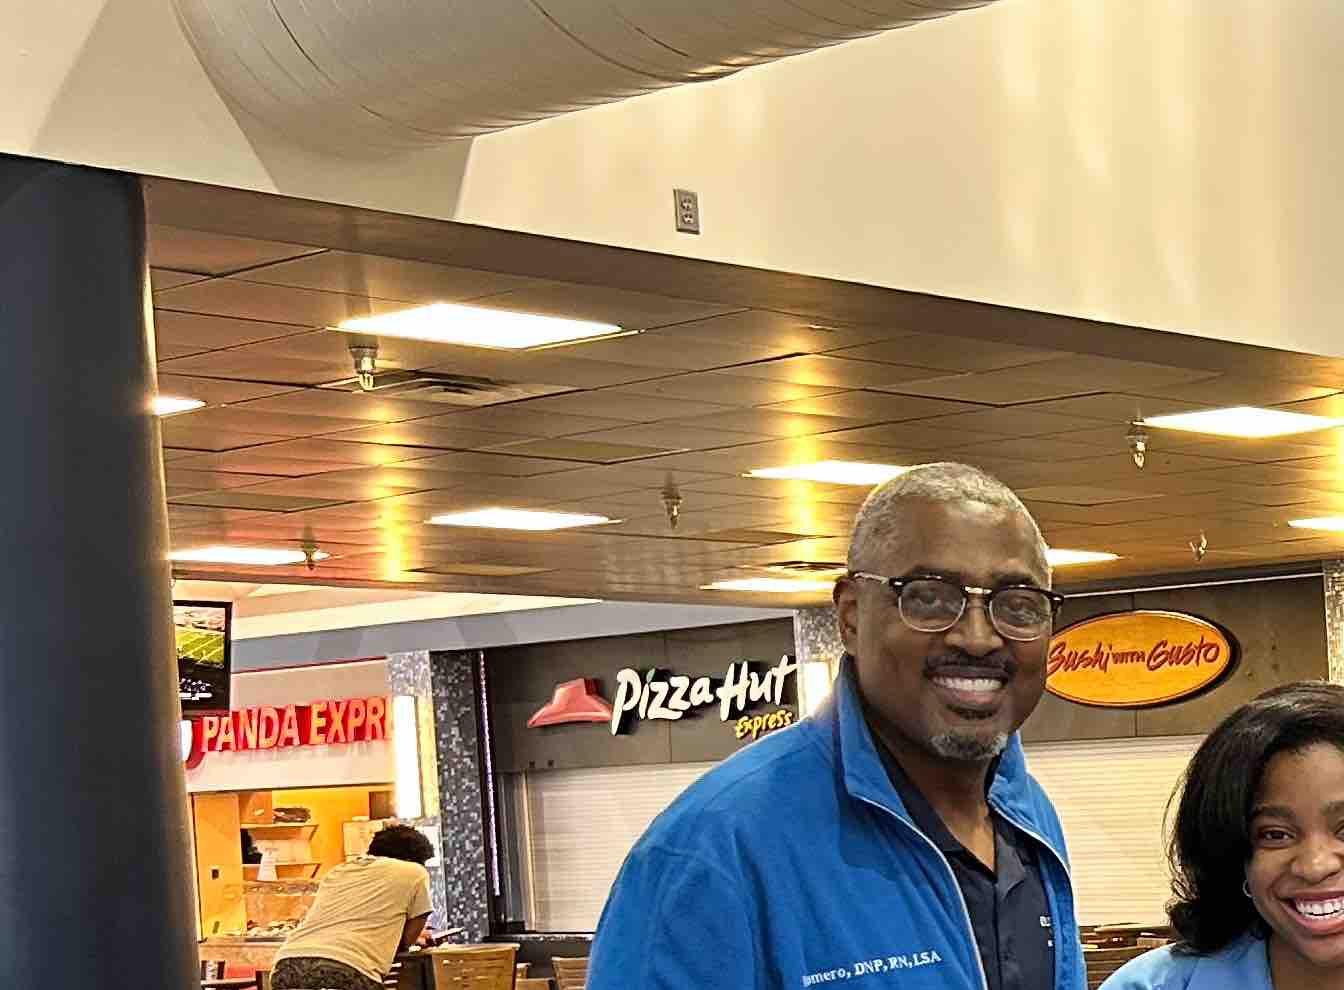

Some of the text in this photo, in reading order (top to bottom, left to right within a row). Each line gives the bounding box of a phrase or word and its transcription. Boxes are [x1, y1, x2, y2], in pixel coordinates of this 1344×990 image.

[1047, 641, 1111, 675] Sushi
[1145, 635, 1220, 671] Gusto
[611, 655, 798, 735] Pizza Hut
[203, 704, 300, 751] PANDA
[735, 709, 793, 738] Express
